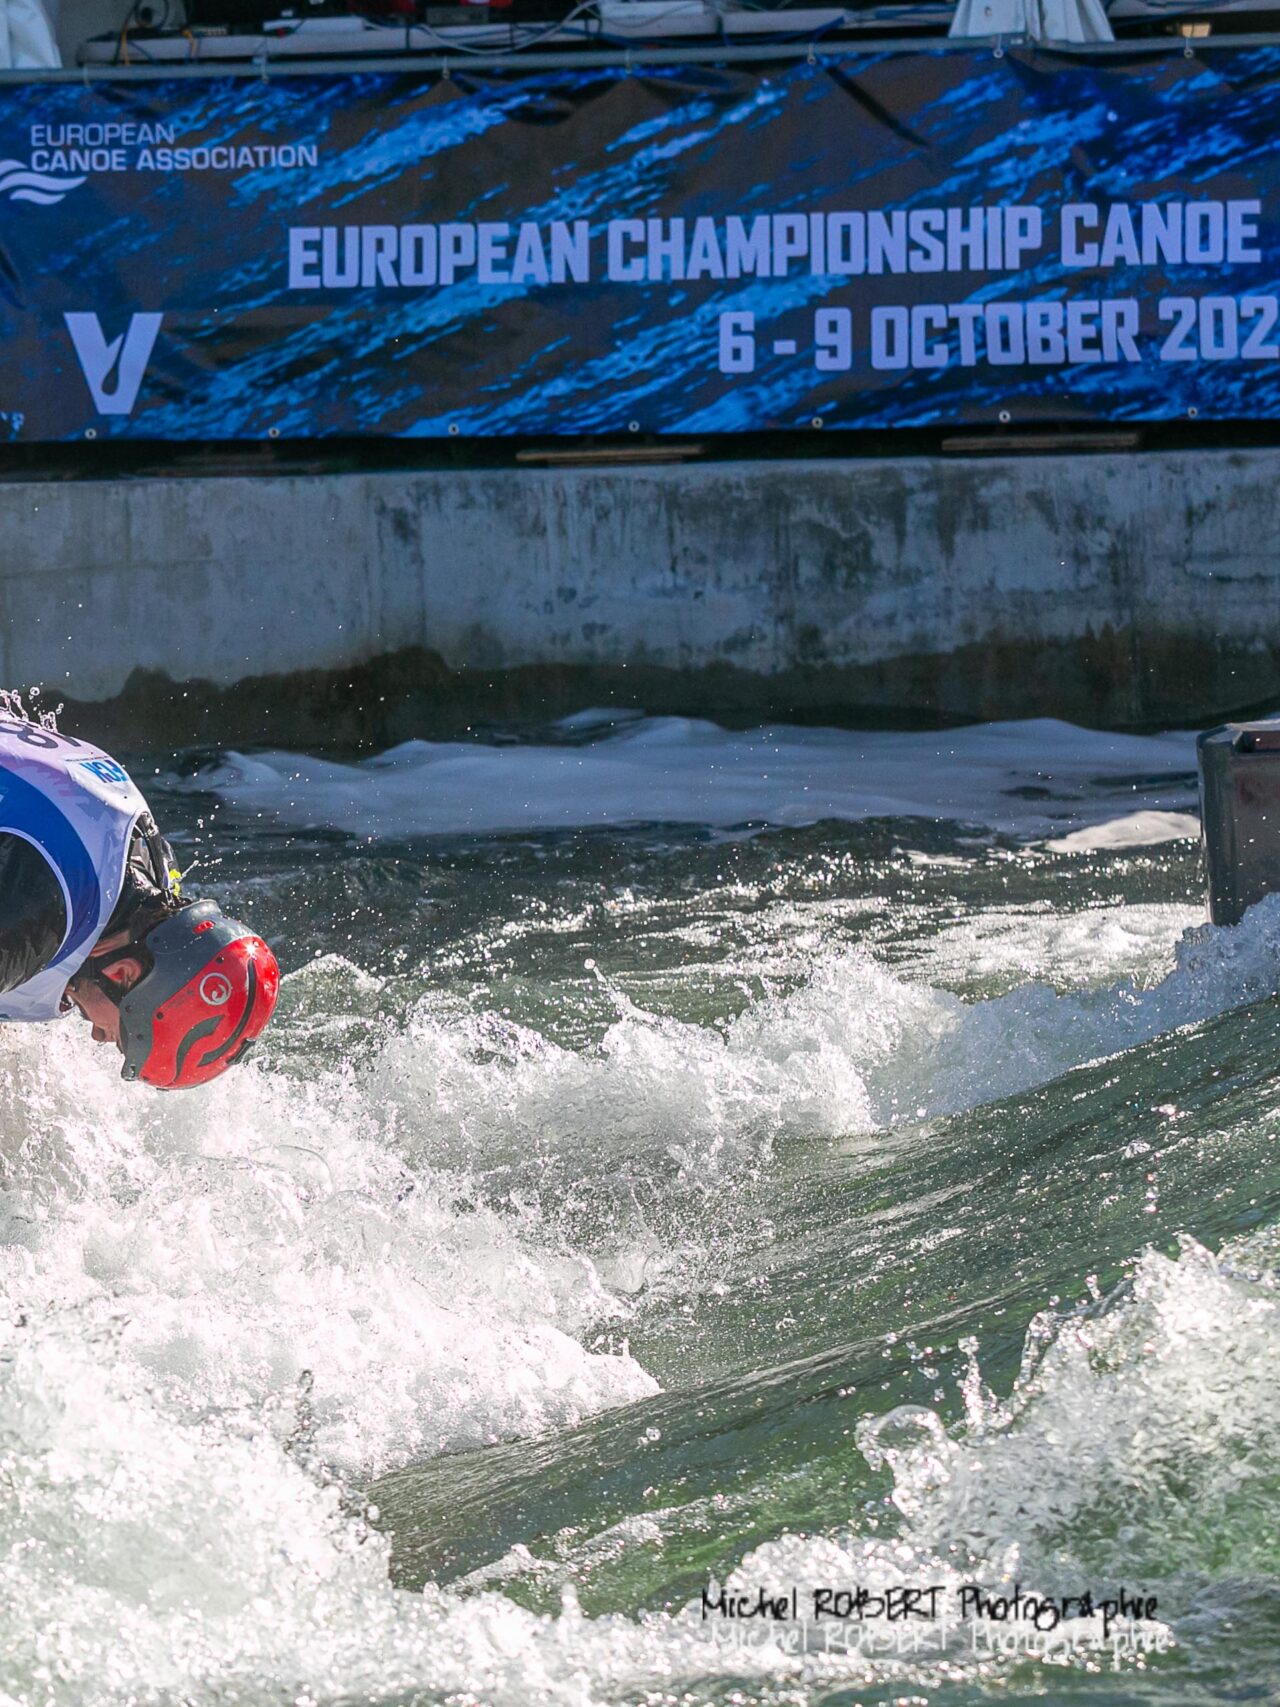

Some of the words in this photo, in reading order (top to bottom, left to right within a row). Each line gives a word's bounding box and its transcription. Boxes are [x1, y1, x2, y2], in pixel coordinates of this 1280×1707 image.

[30, 123, 175, 148] EUROPEAN
[30, 149, 127, 173] CANOE
[136, 145, 318, 172] ASSOCIATION
[287, 219, 590, 290] EUROPEAN
[607, 205, 1043, 283] CHAMPIONSHIP
[1060, 199, 1262, 267] CANOE
[719, 310, 756, 373] 6
[814, 306, 852, 371] 9
[870, 297, 1142, 370] OCTOBER
